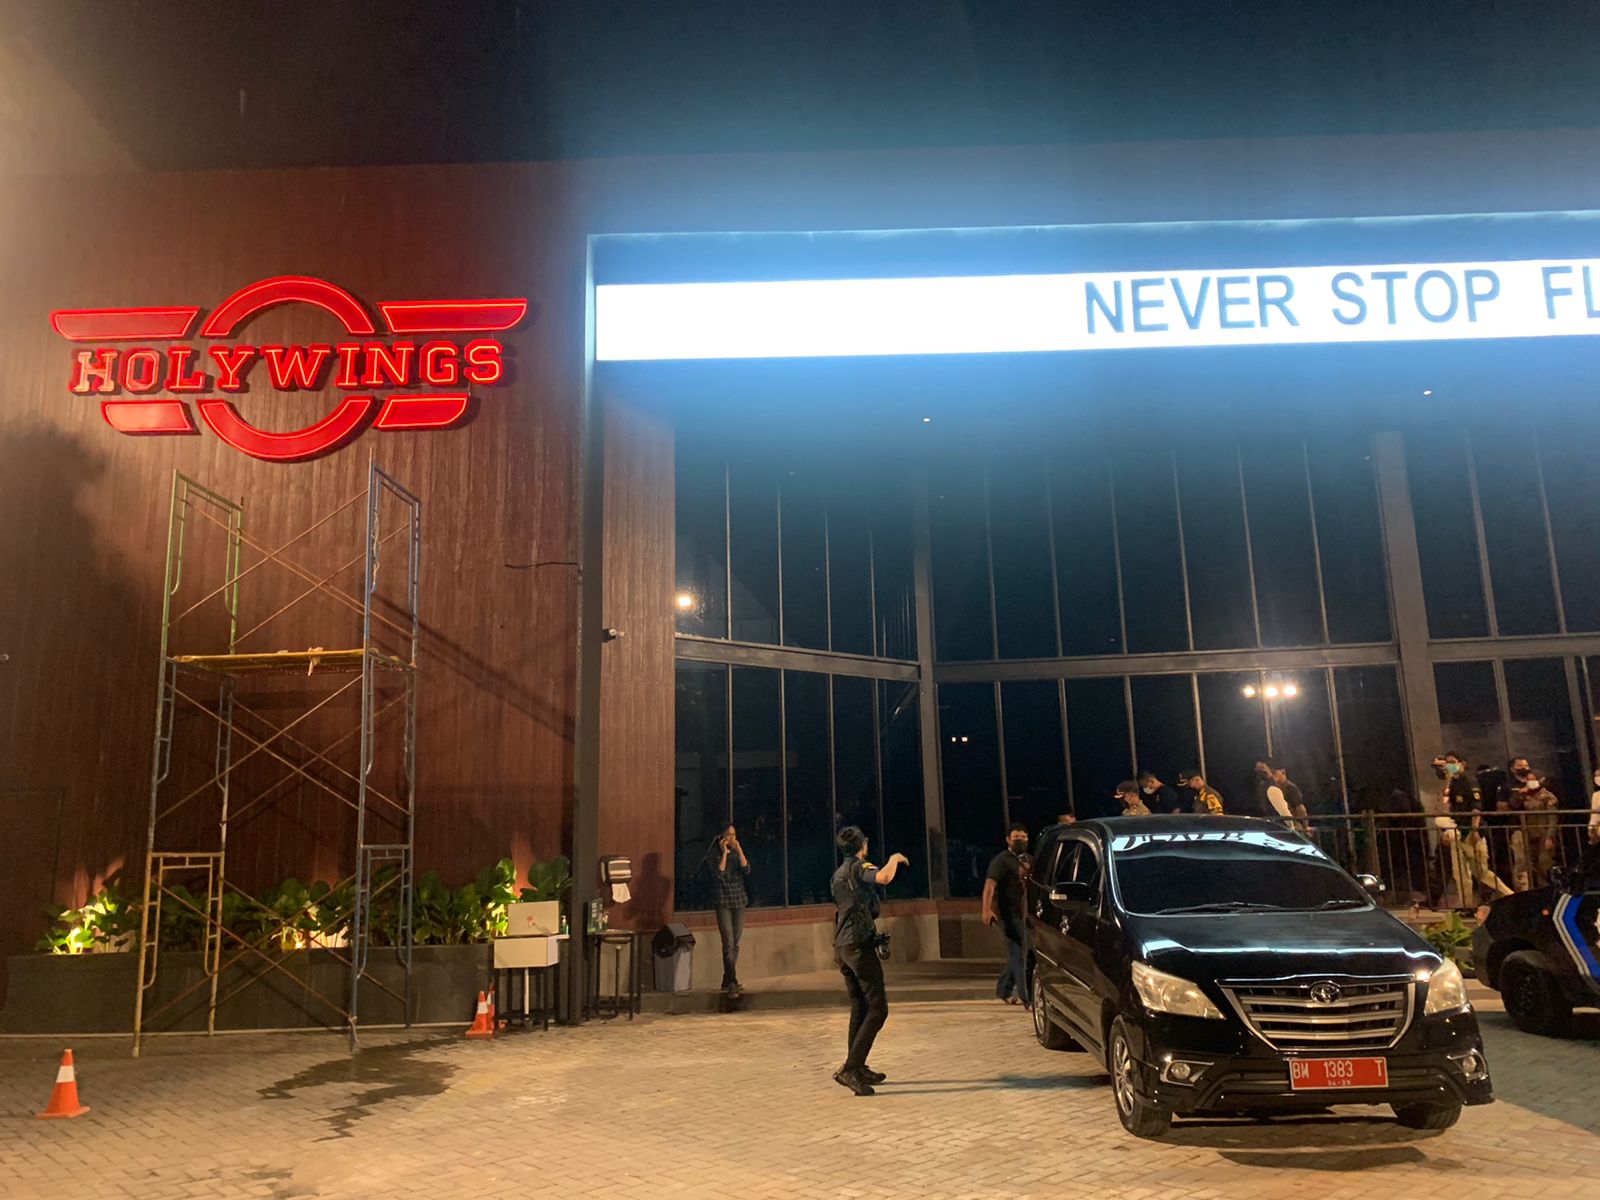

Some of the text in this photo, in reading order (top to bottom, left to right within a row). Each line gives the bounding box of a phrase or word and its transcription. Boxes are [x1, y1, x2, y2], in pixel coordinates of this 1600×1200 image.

[1085, 265, 1600, 334] NEVER STOP FL
[68, 338, 504, 395] HOLYWINGS
[1292, 1062, 1310, 1079] BM
[1323, 1060, 1354, 1078] 1383
